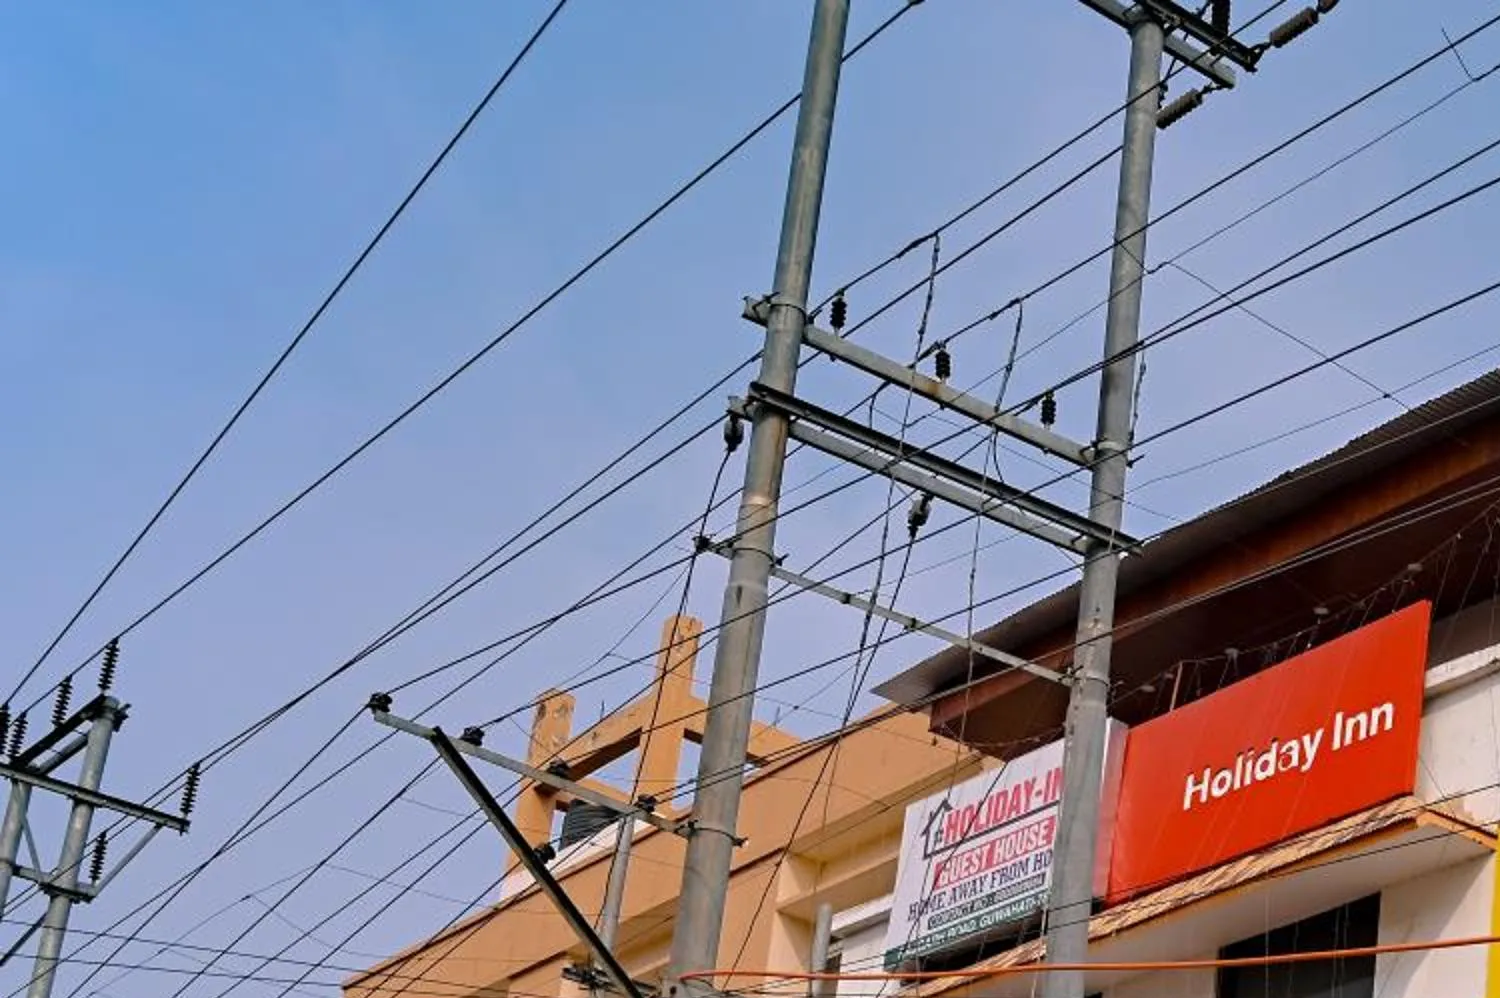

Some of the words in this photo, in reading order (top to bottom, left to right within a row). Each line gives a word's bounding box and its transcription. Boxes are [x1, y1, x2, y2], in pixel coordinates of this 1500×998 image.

[1183, 727, 1323, 810] Holiday
[1331, 701, 1394, 752] Inn
[938, 848, 990, 886] GUEST
[993, 823, 1050, 868] HOUSE
[949, 873, 990, 903] AWAY
[989, 858, 1030, 892] FROM
